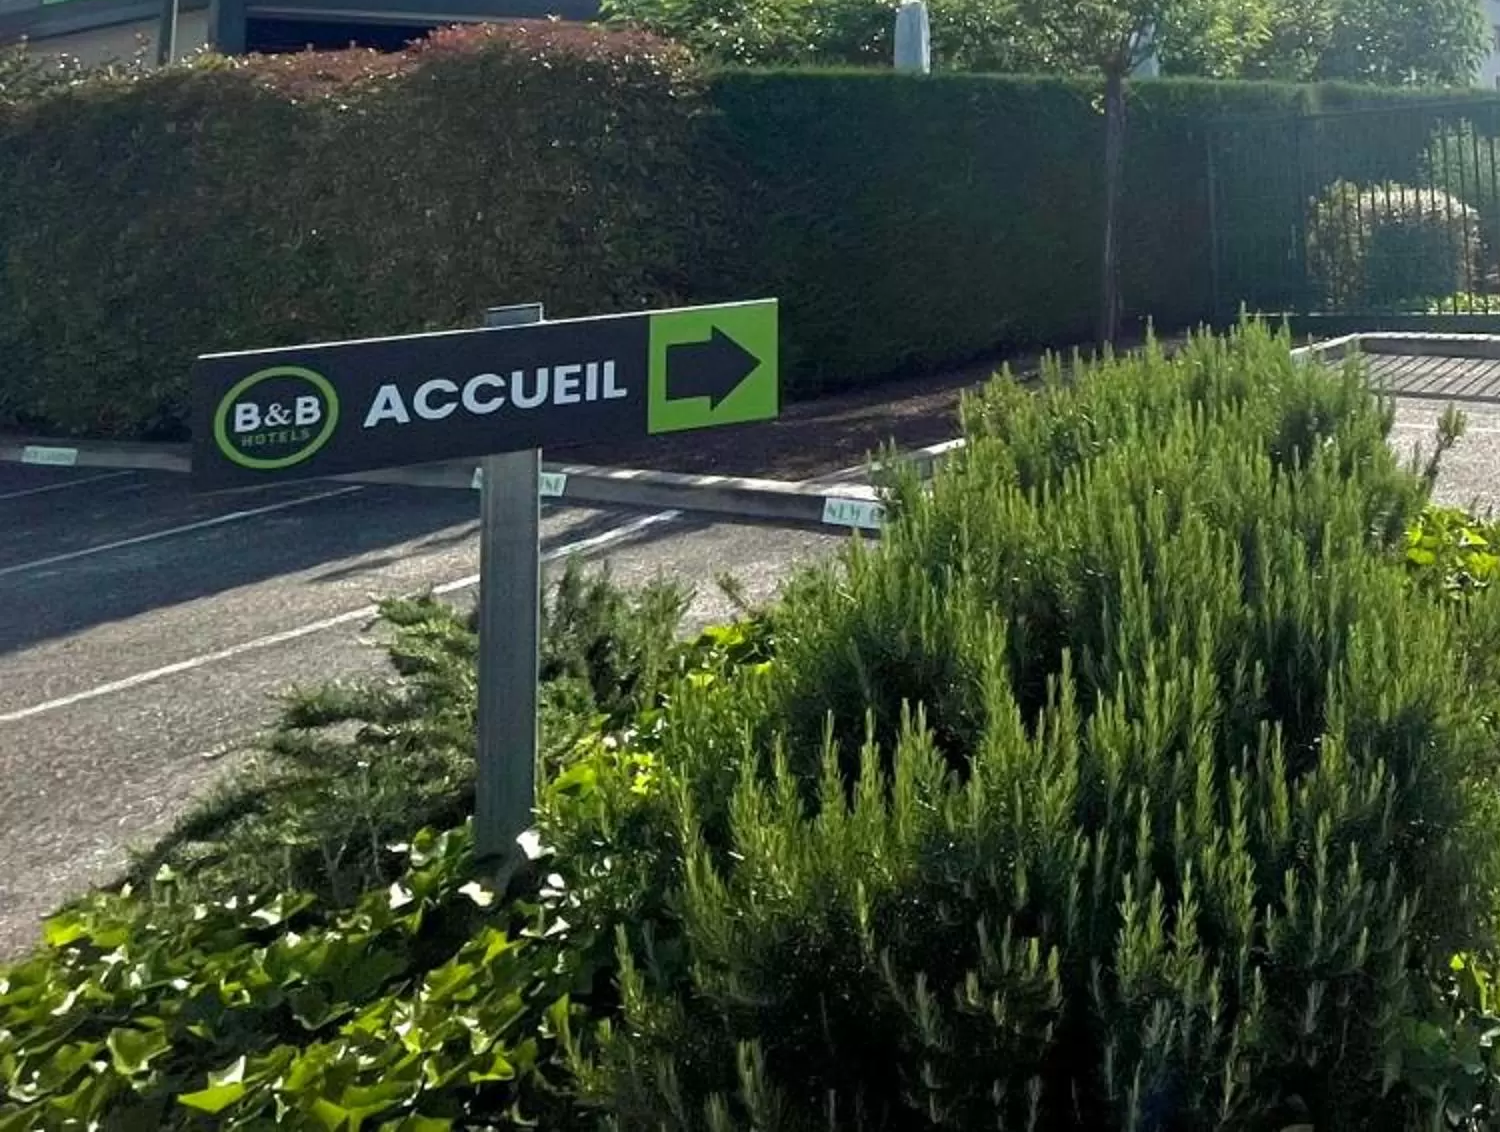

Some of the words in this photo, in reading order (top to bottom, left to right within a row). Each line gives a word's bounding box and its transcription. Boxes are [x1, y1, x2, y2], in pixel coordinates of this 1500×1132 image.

[363, 360, 628, 428] ACCUEIL
[234, 395, 321, 433] B&B
[241, 427, 311, 447] HOTELS
